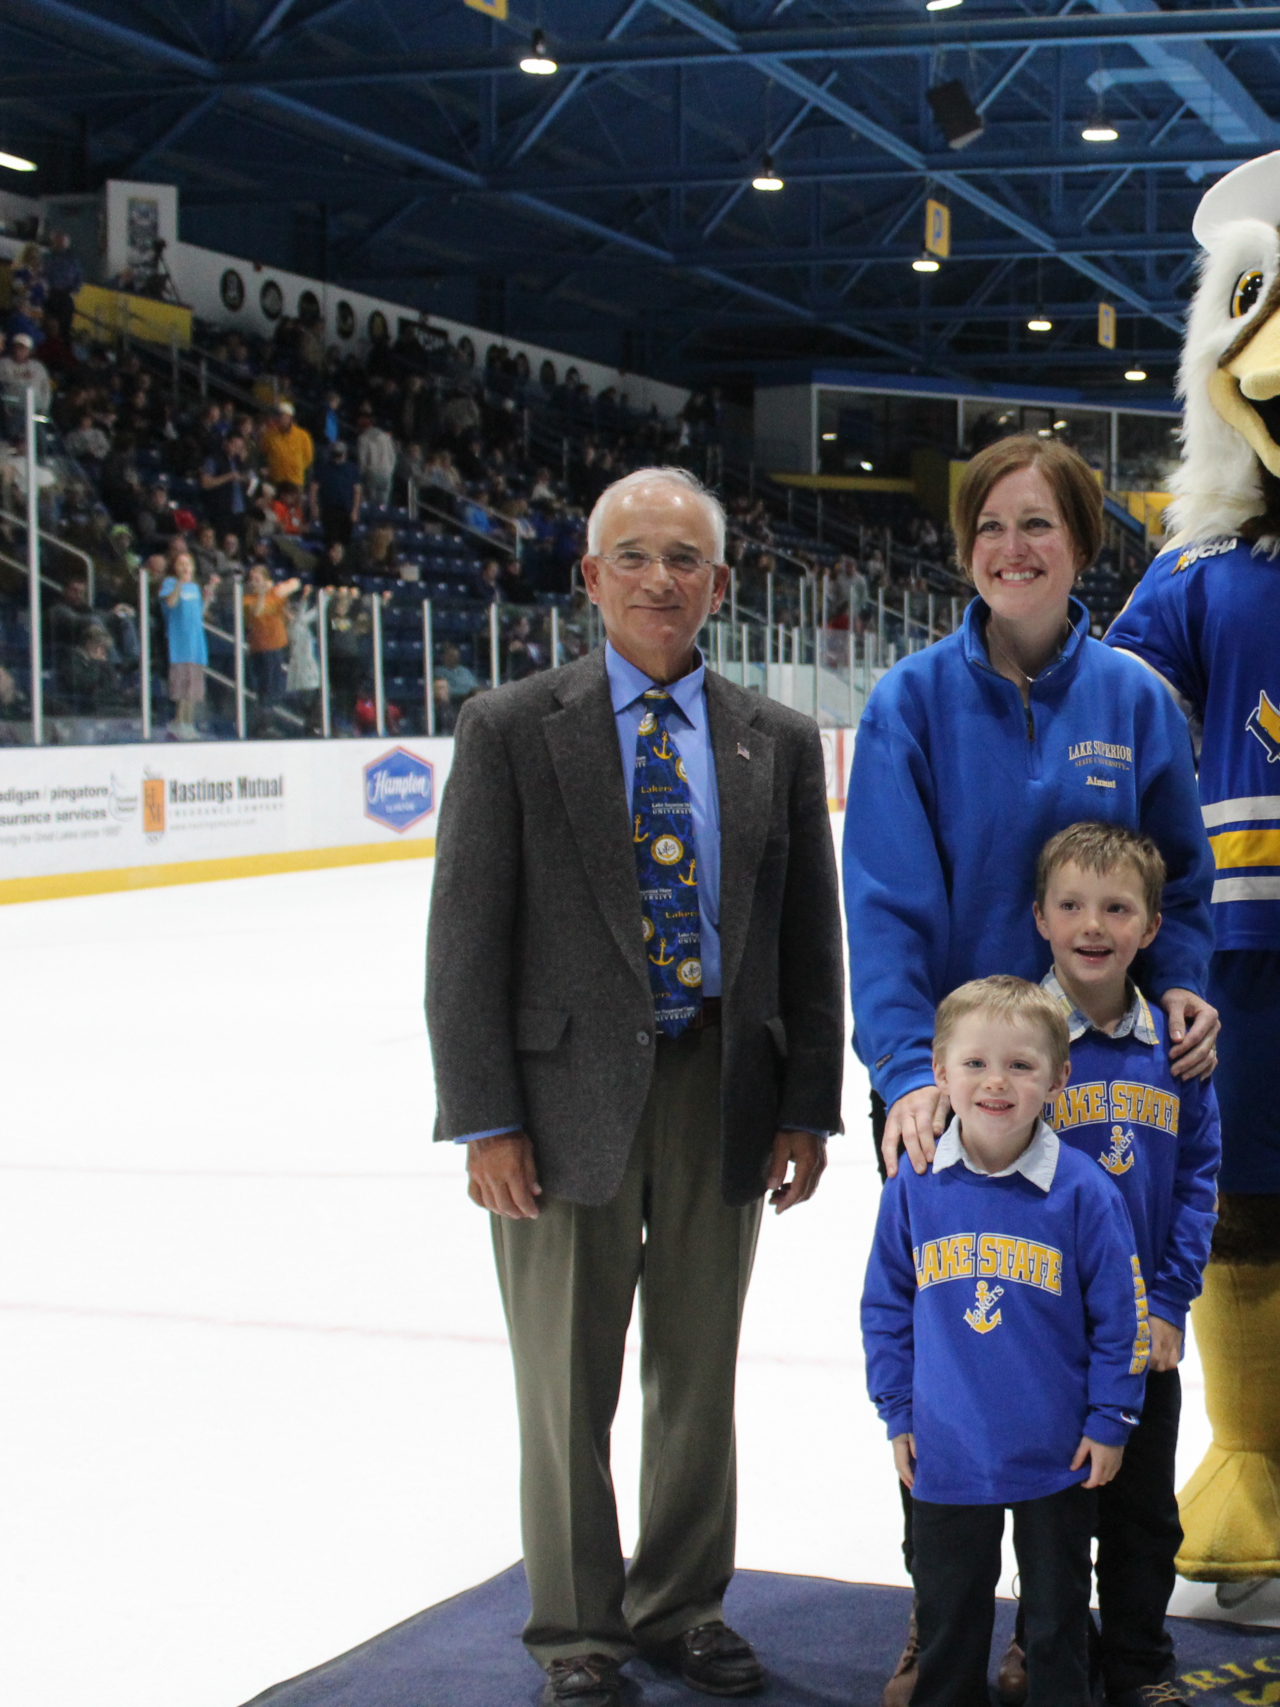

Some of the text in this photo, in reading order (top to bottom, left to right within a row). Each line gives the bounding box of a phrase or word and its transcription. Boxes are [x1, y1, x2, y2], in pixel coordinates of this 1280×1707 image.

[1067, 740, 1133, 762] LAKE SUPERIOR
[50, 786, 109, 804] pingatore
[169, 774, 283, 804] Hastings Mutual
[366, 769, 430, 805] Hampton
[55, 809, 107, 823] services
[1109, 1080, 1181, 1137] STATE
[1097, 1128, 1135, 1171] Lakers
[977, 1232, 1063, 1297] STATE
[963, 1284, 1005, 1329] Lakers
